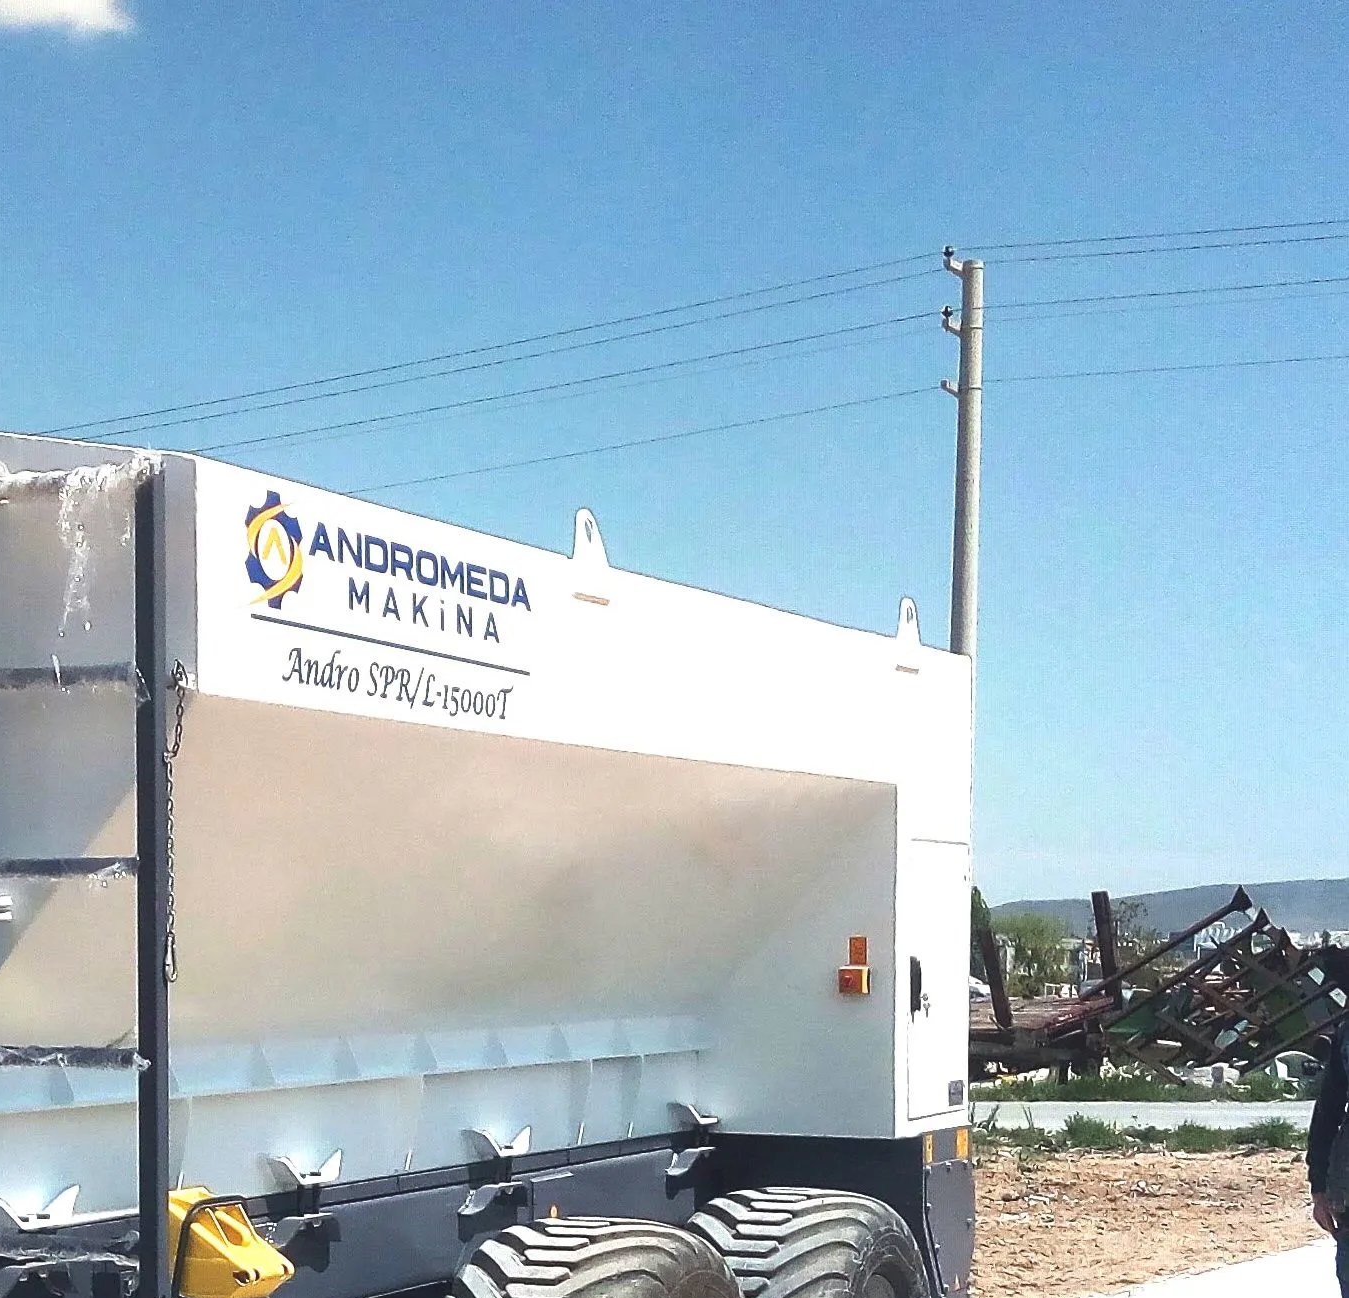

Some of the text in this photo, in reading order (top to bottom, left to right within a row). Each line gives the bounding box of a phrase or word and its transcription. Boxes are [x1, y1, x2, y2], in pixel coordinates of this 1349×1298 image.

[308, 521, 532, 612] ANDROMEDA
[281, 647, 514, 720] Andro SPR/L-15000T
